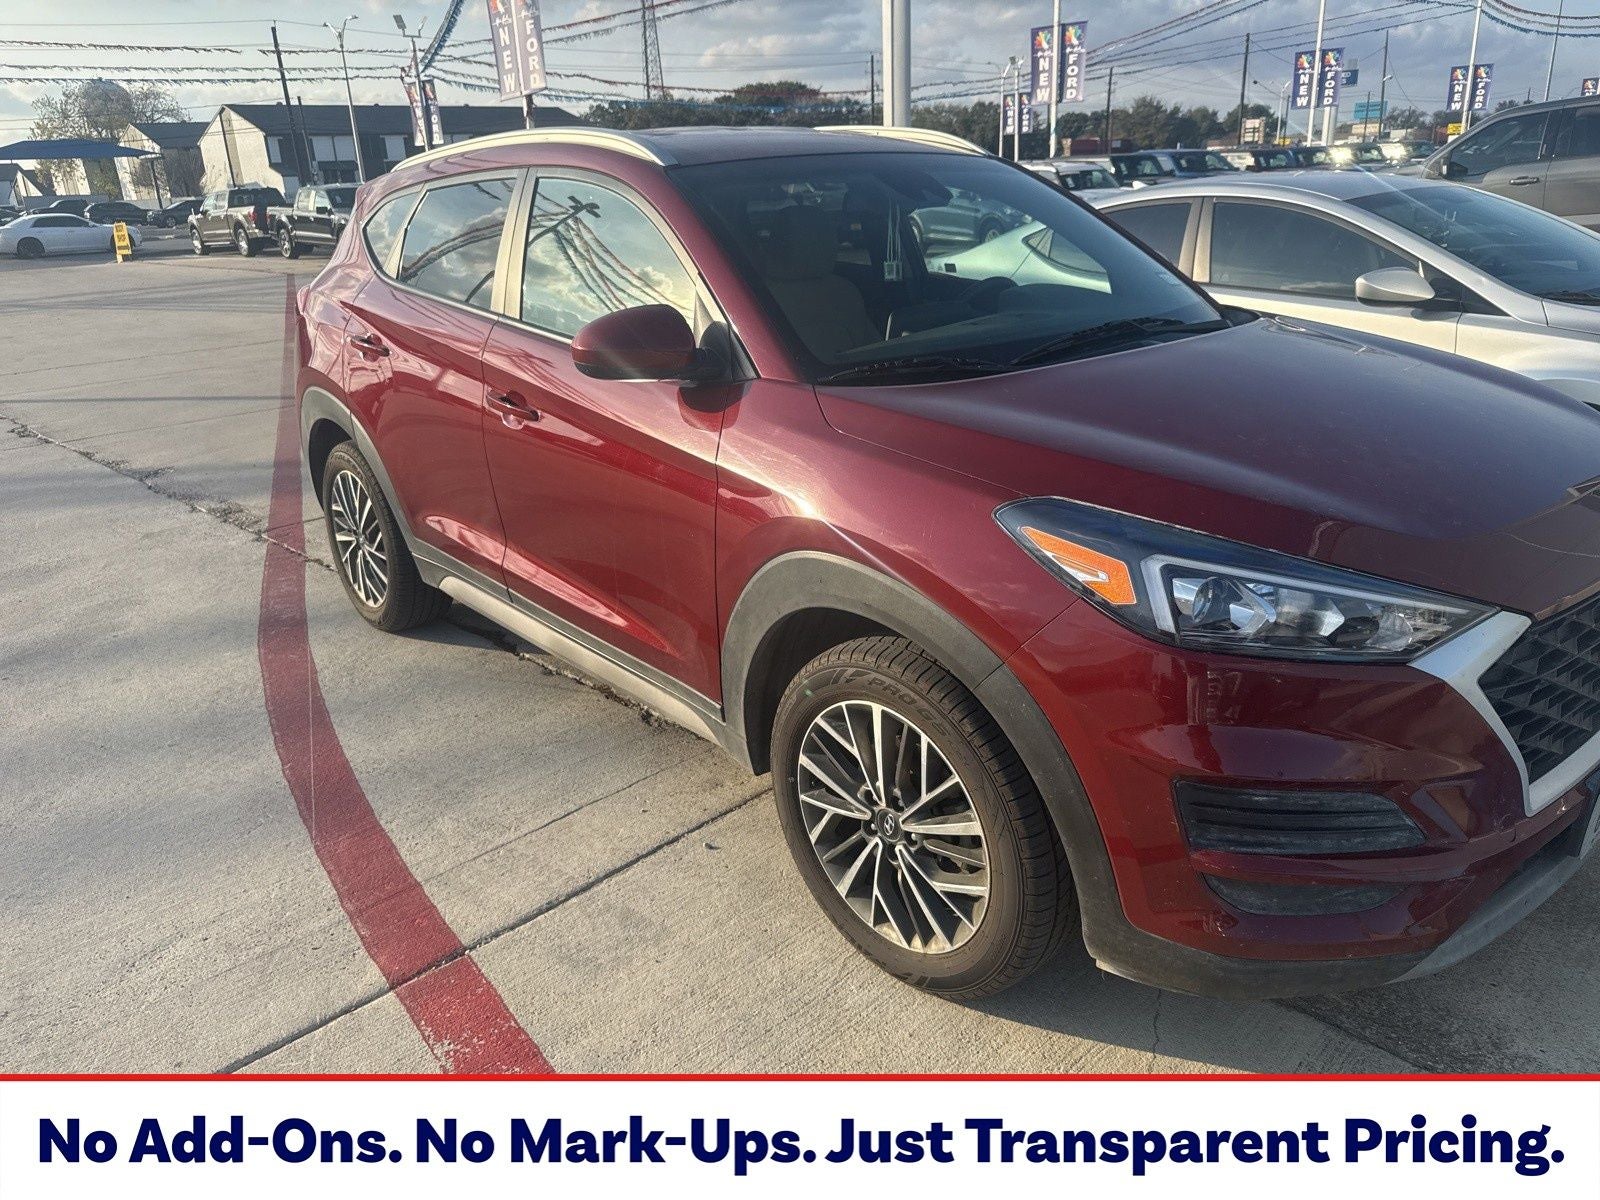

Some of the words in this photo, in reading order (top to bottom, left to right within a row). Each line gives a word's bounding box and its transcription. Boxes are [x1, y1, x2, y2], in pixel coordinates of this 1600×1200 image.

[499, 26, 515, 93] NEW
[525, 19, 542, 89] FORD
[1036, 57, 1050, 102] NEW
[1065, 53, 1079, 100] FORD
[1296, 73, 1310, 107] NEW
[1323, 71, 1336, 105] FORD
[1474, 82, 1486, 109] FORD
[1451, 84, 1464, 111] NEW
